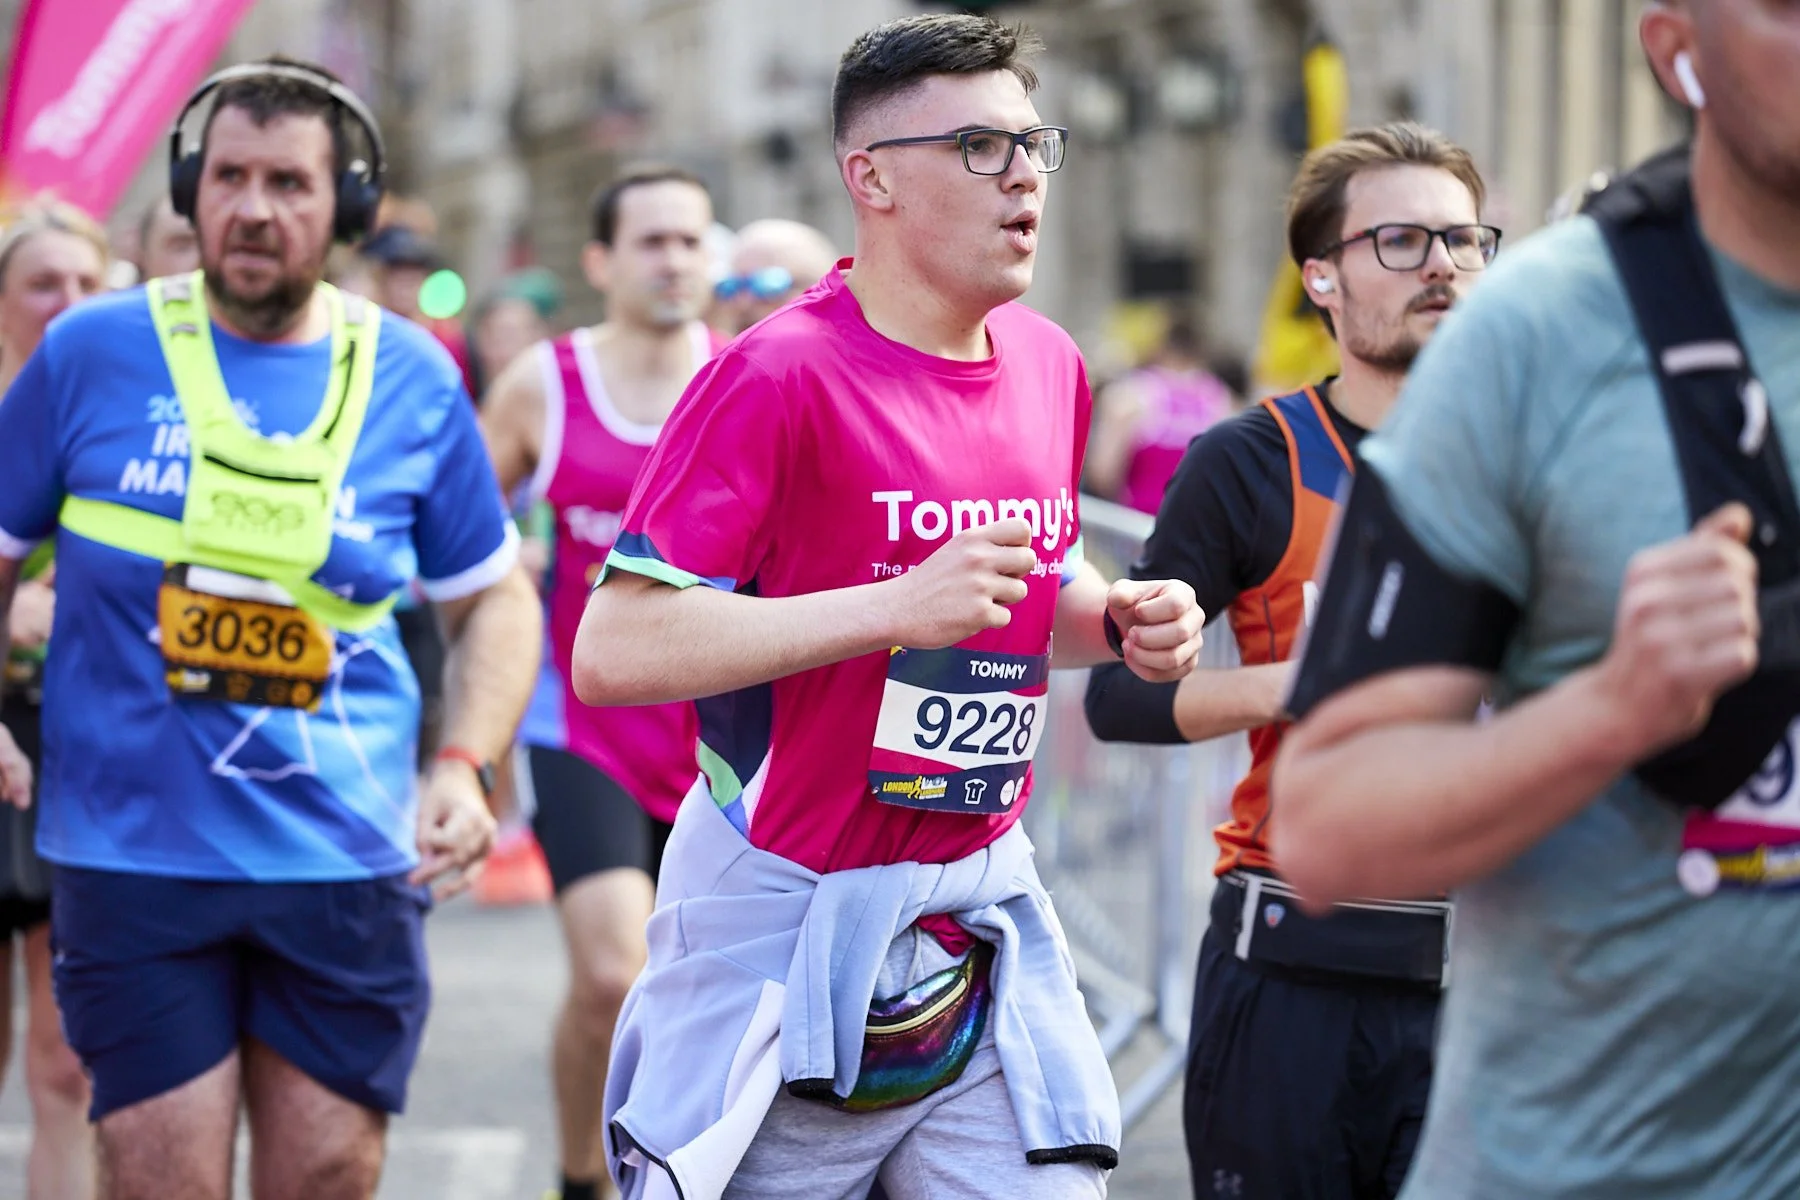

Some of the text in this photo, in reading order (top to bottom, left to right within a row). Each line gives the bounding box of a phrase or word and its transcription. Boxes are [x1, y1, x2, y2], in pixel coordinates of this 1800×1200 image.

[872, 487, 1074, 551] Tommy's
[871, 562, 902, 577] The
[177, 605, 308, 662] 3036
[969, 660, 1028, 680] TOMMY
[913, 695, 1036, 756] 9228
[882, 781, 914, 793] LONDON
